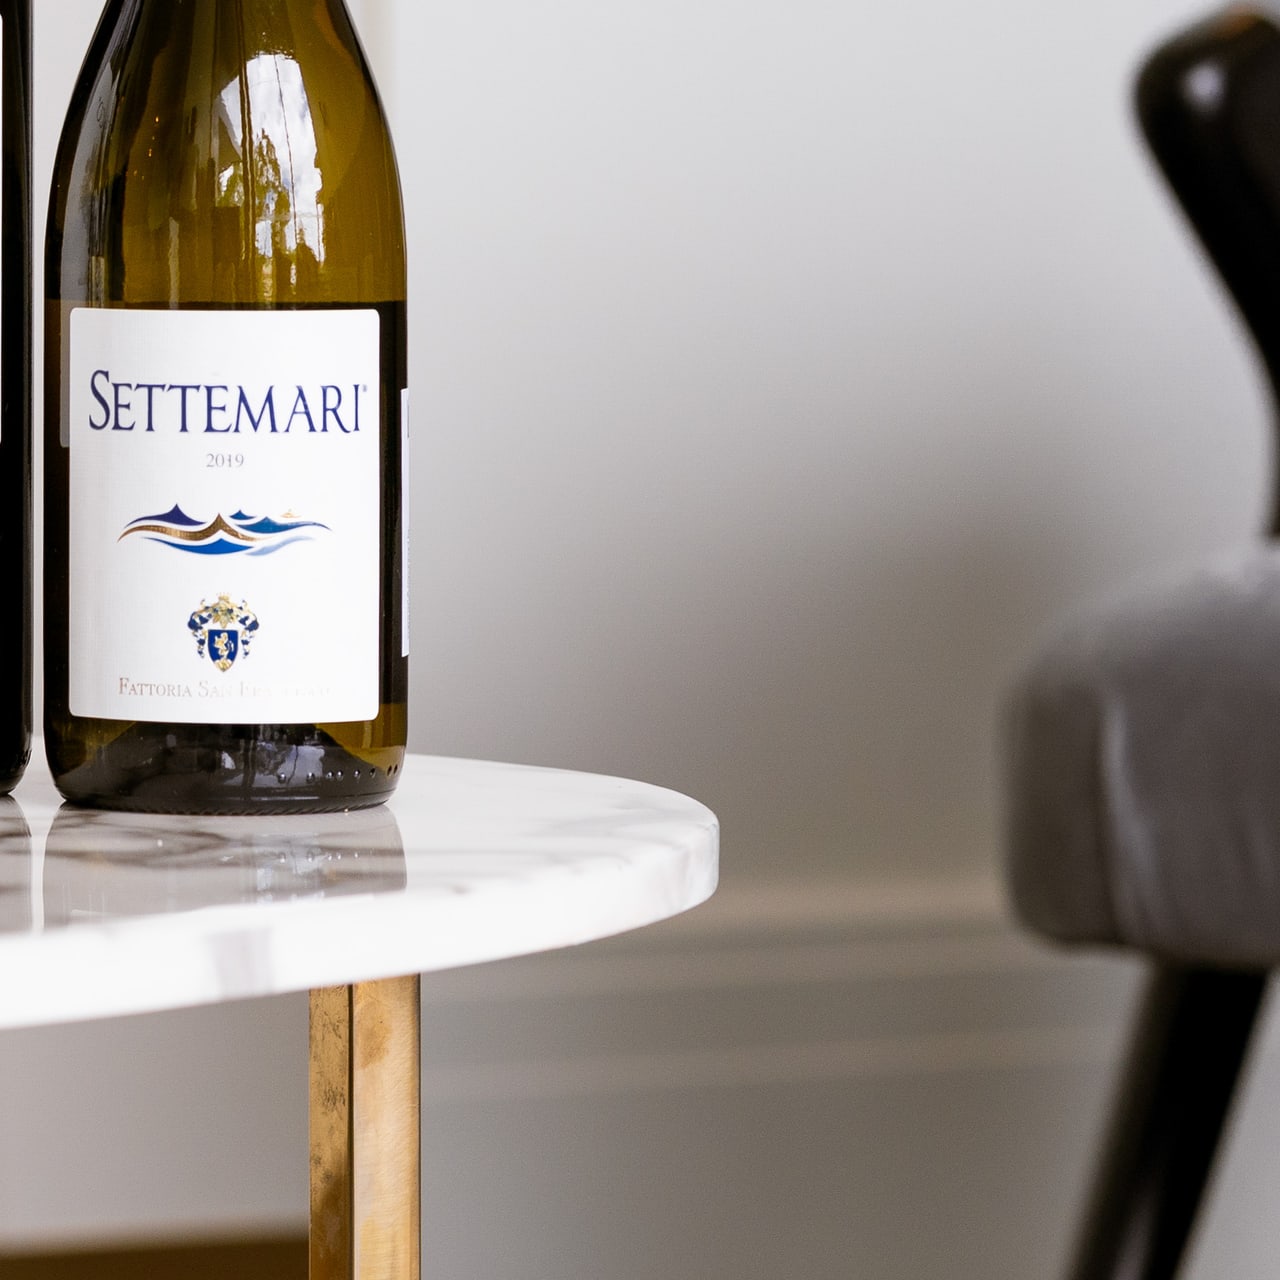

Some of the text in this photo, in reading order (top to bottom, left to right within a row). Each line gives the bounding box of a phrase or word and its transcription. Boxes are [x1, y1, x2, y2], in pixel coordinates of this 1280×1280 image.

[89, 370, 361, 434] SETTEMARI
[206, 453, 244, 468] 2019
[118, 677, 192, 697] FATTORIA
